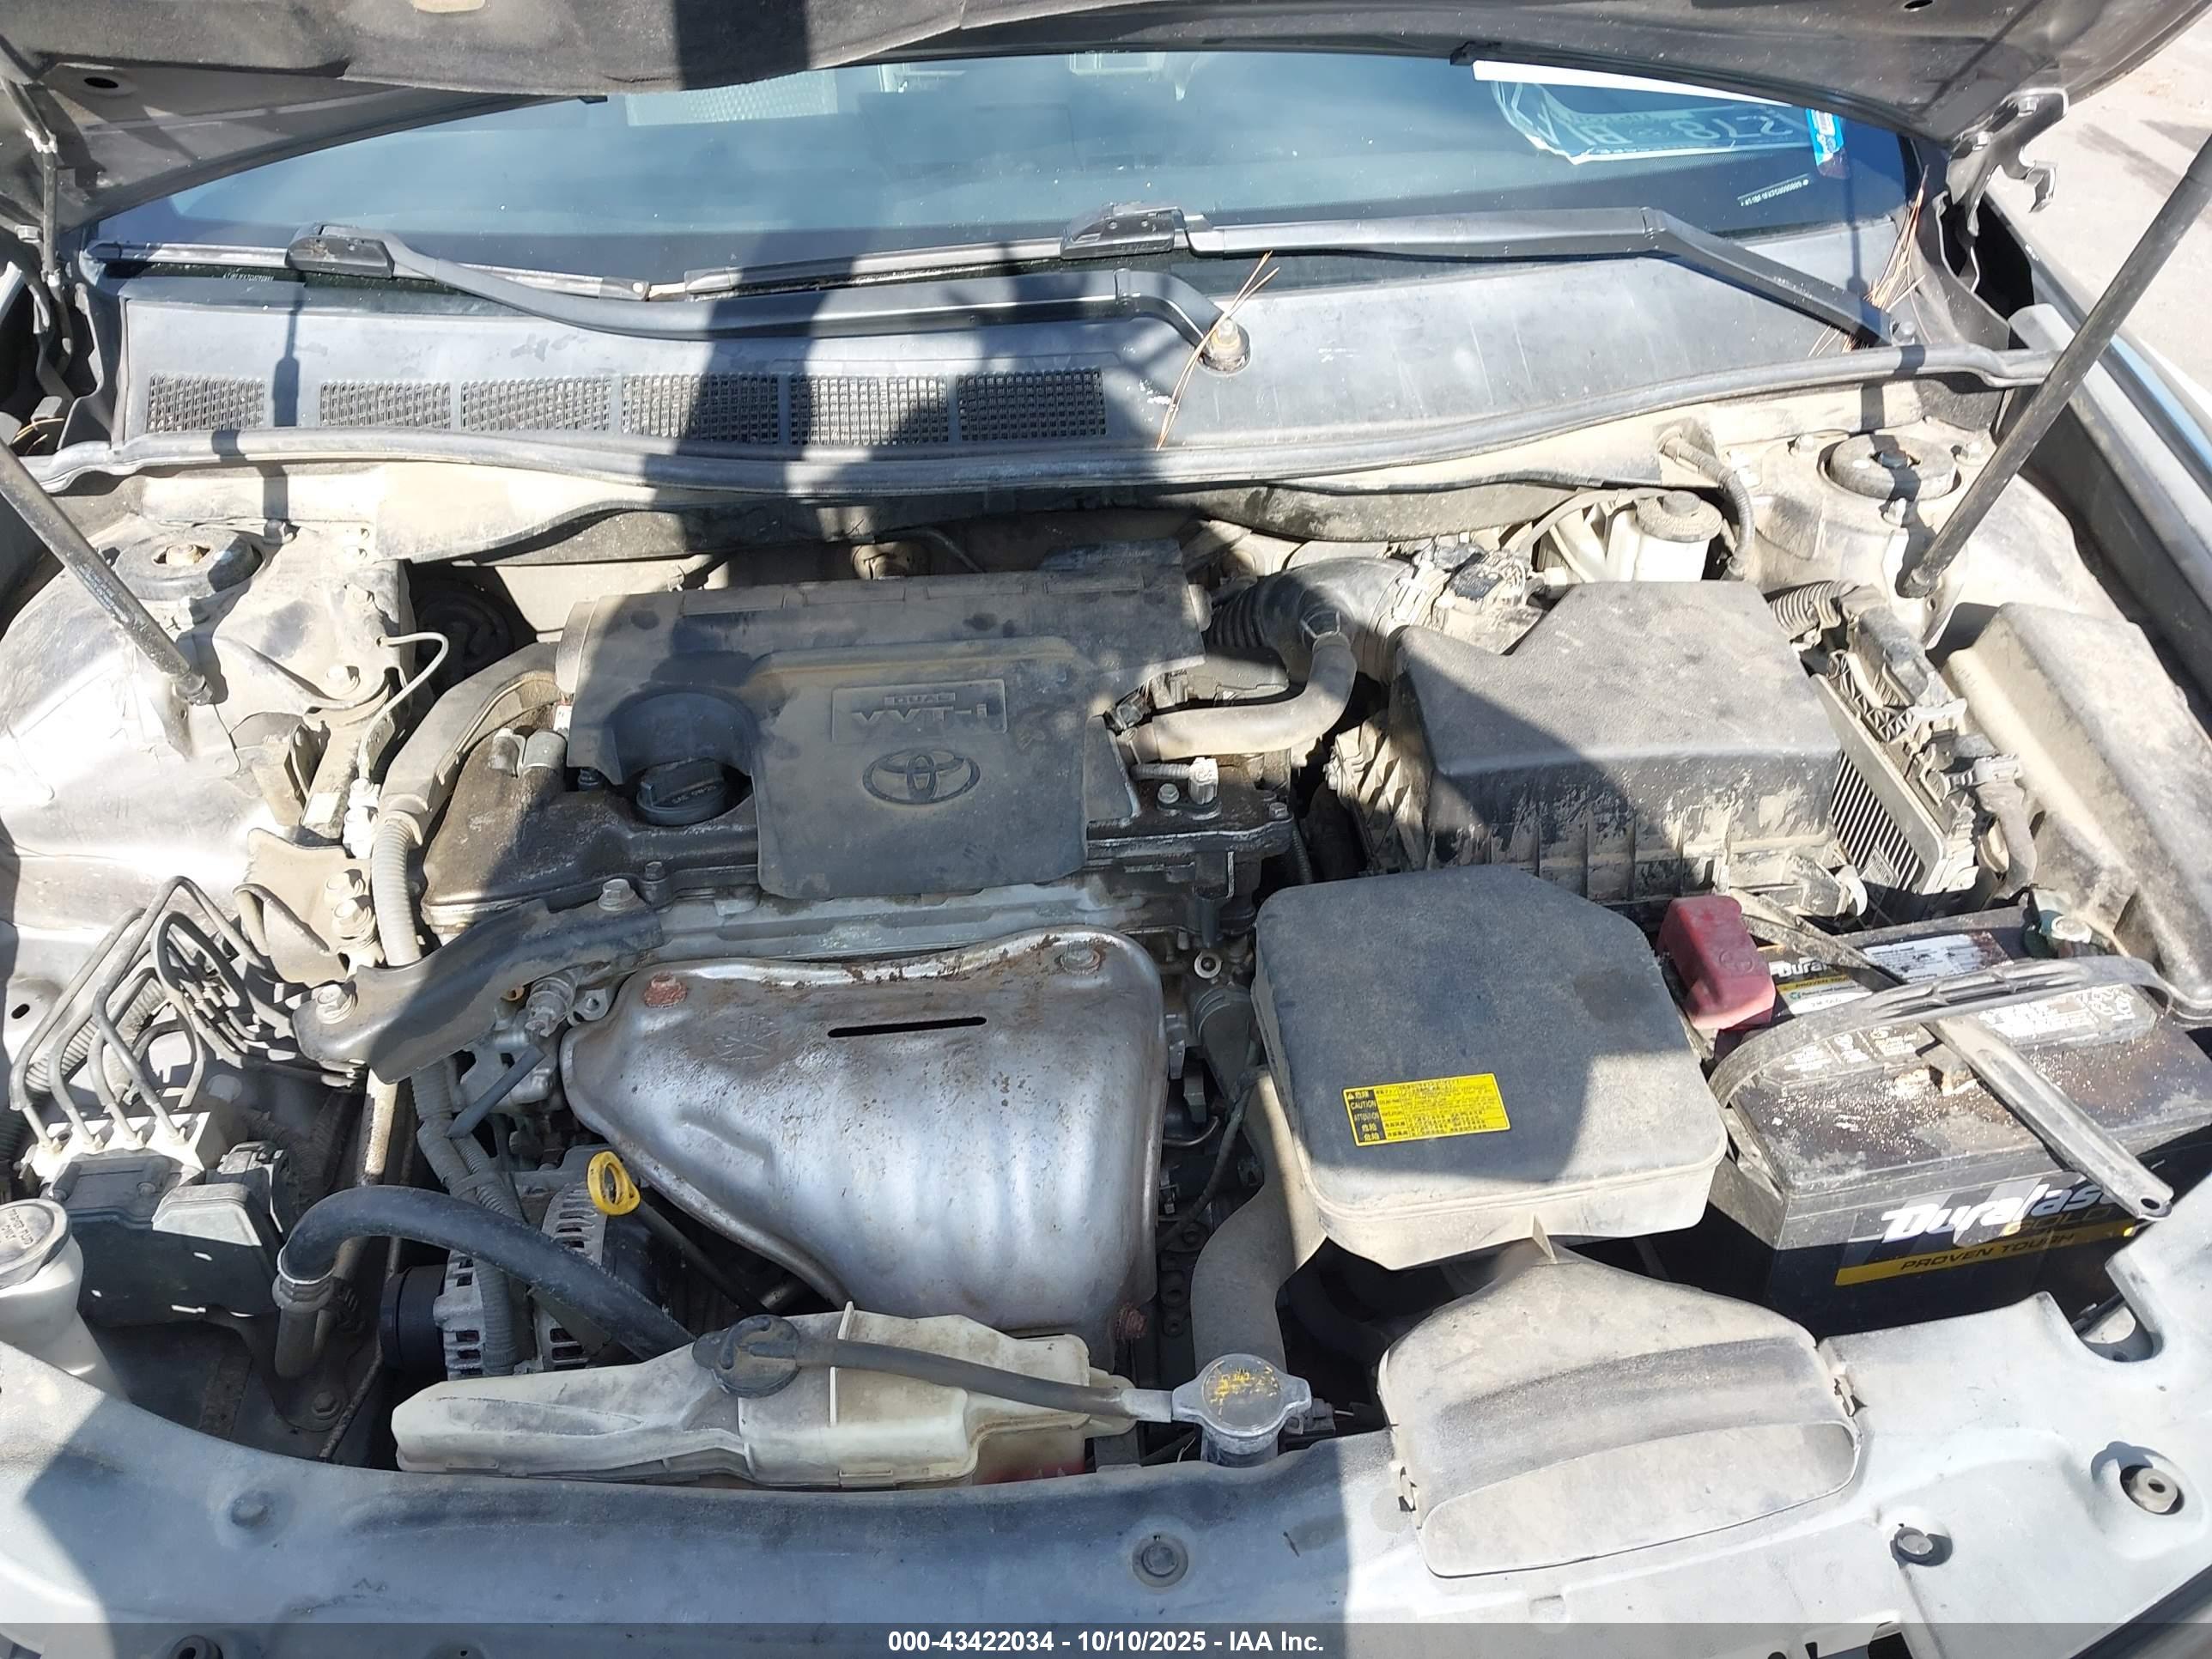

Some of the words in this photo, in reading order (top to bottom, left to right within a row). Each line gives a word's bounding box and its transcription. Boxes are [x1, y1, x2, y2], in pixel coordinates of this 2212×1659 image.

[884, 692, 956, 706] DUAL
[1350, 1098, 1377, 1110] CAUTION
[1353, 1111, 1380, 1122] ATTENTION
[1881, 1183, 2117, 1243] Duralas
[1900, 1247, 1994, 1271] PROVEN
[2001, 1232, 2075, 1255] TOUGH
